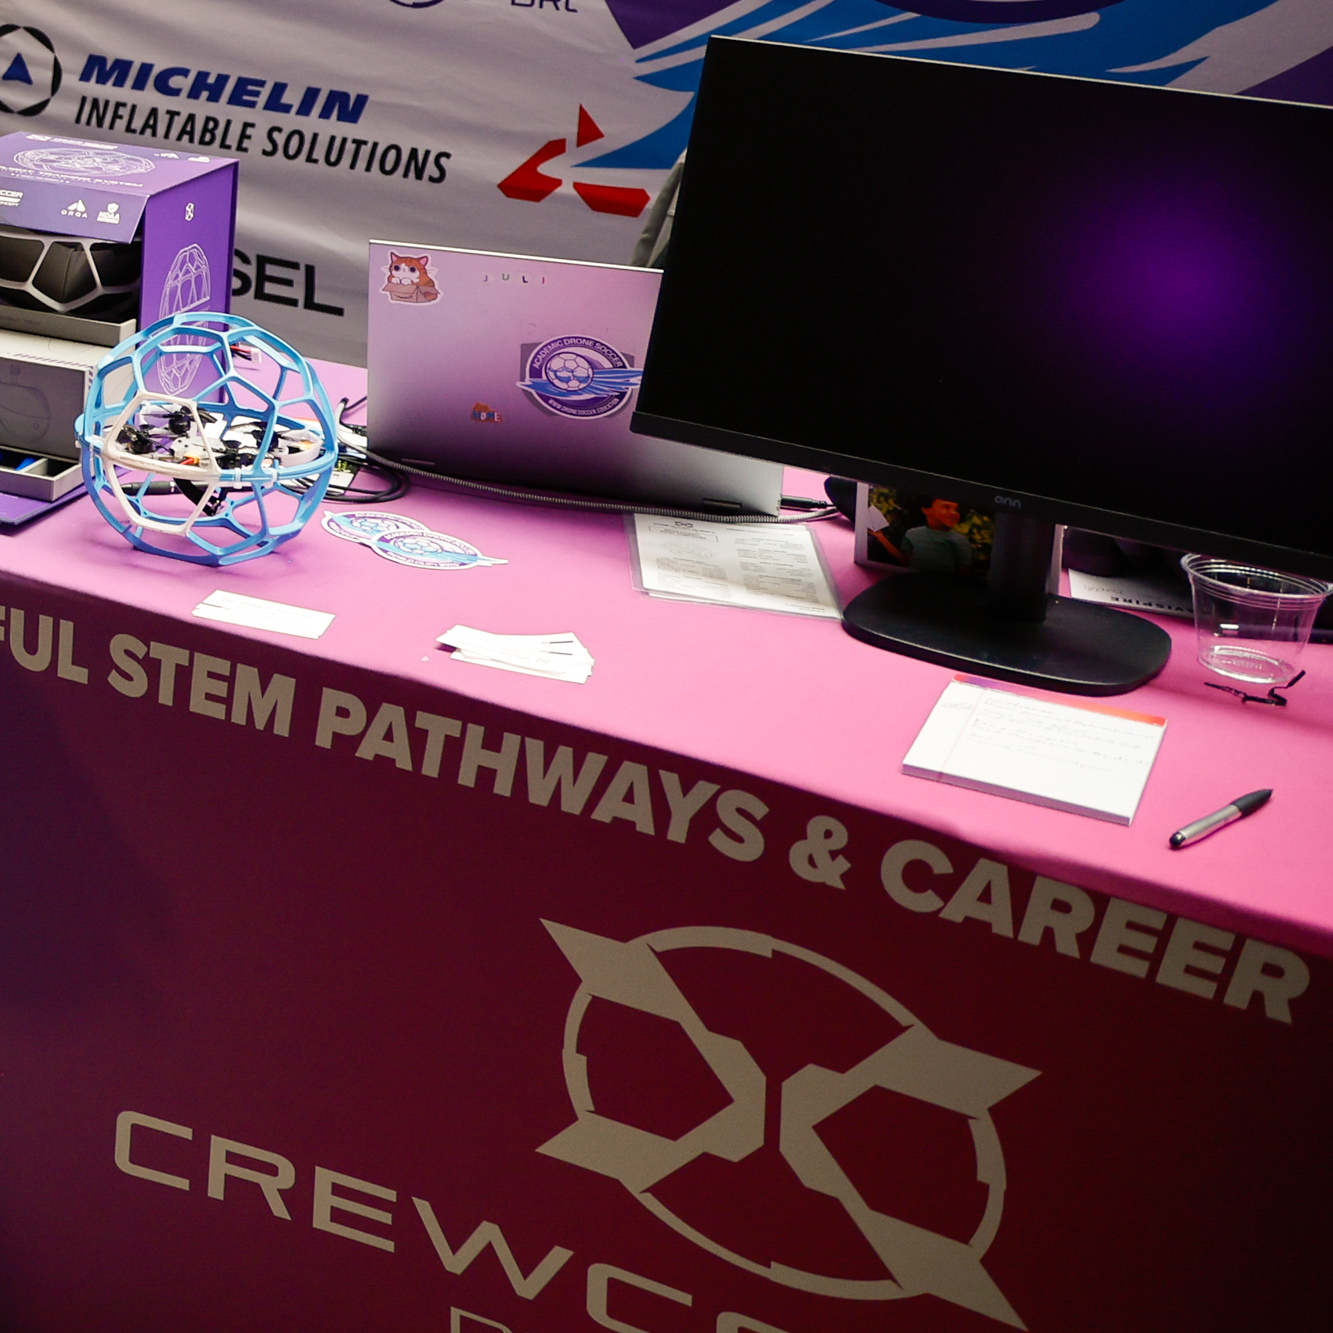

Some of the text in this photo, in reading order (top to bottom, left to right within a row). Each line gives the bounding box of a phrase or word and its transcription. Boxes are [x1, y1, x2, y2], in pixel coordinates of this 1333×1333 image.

[79, 55, 370, 124] MICHELIN
[75, 96, 452, 185] INFLATABLE SOLUTIONS
[61, 209, 88, 218] ORQA
[232, 245, 345, 318] SEL
[533, 338, 624, 369] ACADEMIC DRONE SOCCER
[107, 633, 296, 738] STEM
[314, 687, 769, 863] PATHWAYS
[788, 815, 851, 891] &
[880, 839, 1311, 1025] CAREER
